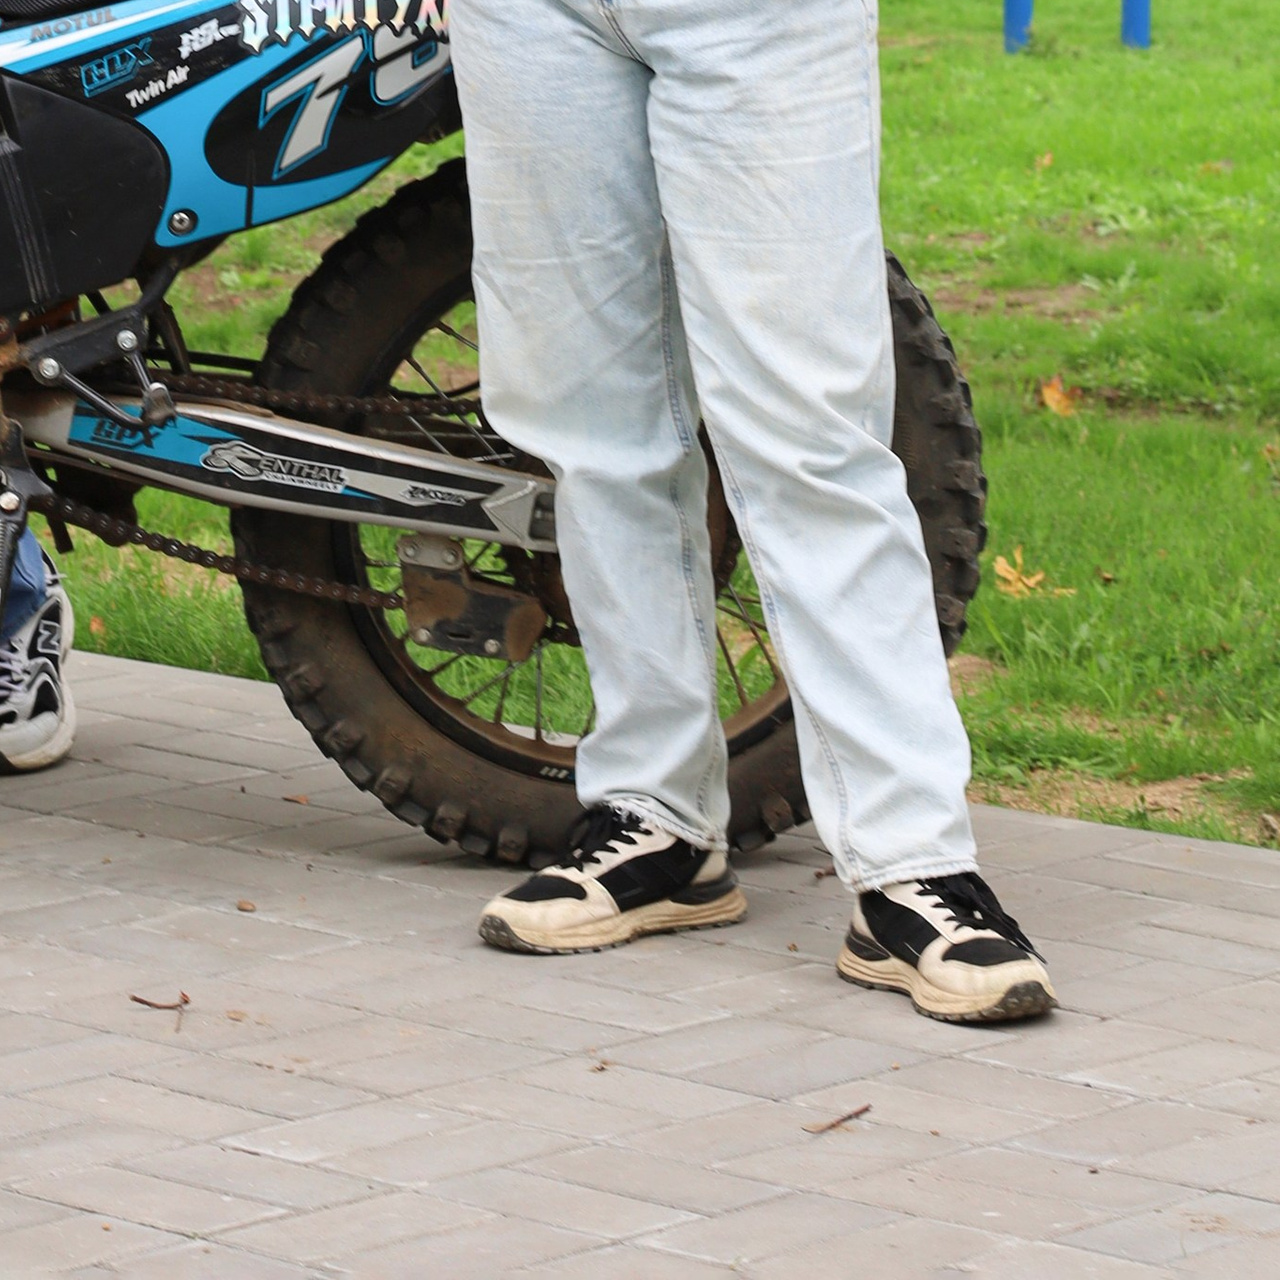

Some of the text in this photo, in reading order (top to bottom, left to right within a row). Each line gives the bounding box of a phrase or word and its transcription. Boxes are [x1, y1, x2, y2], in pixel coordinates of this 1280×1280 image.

[29, 6, 118, 43] MOTUL
[125, 64, 191, 109] Twin Air
